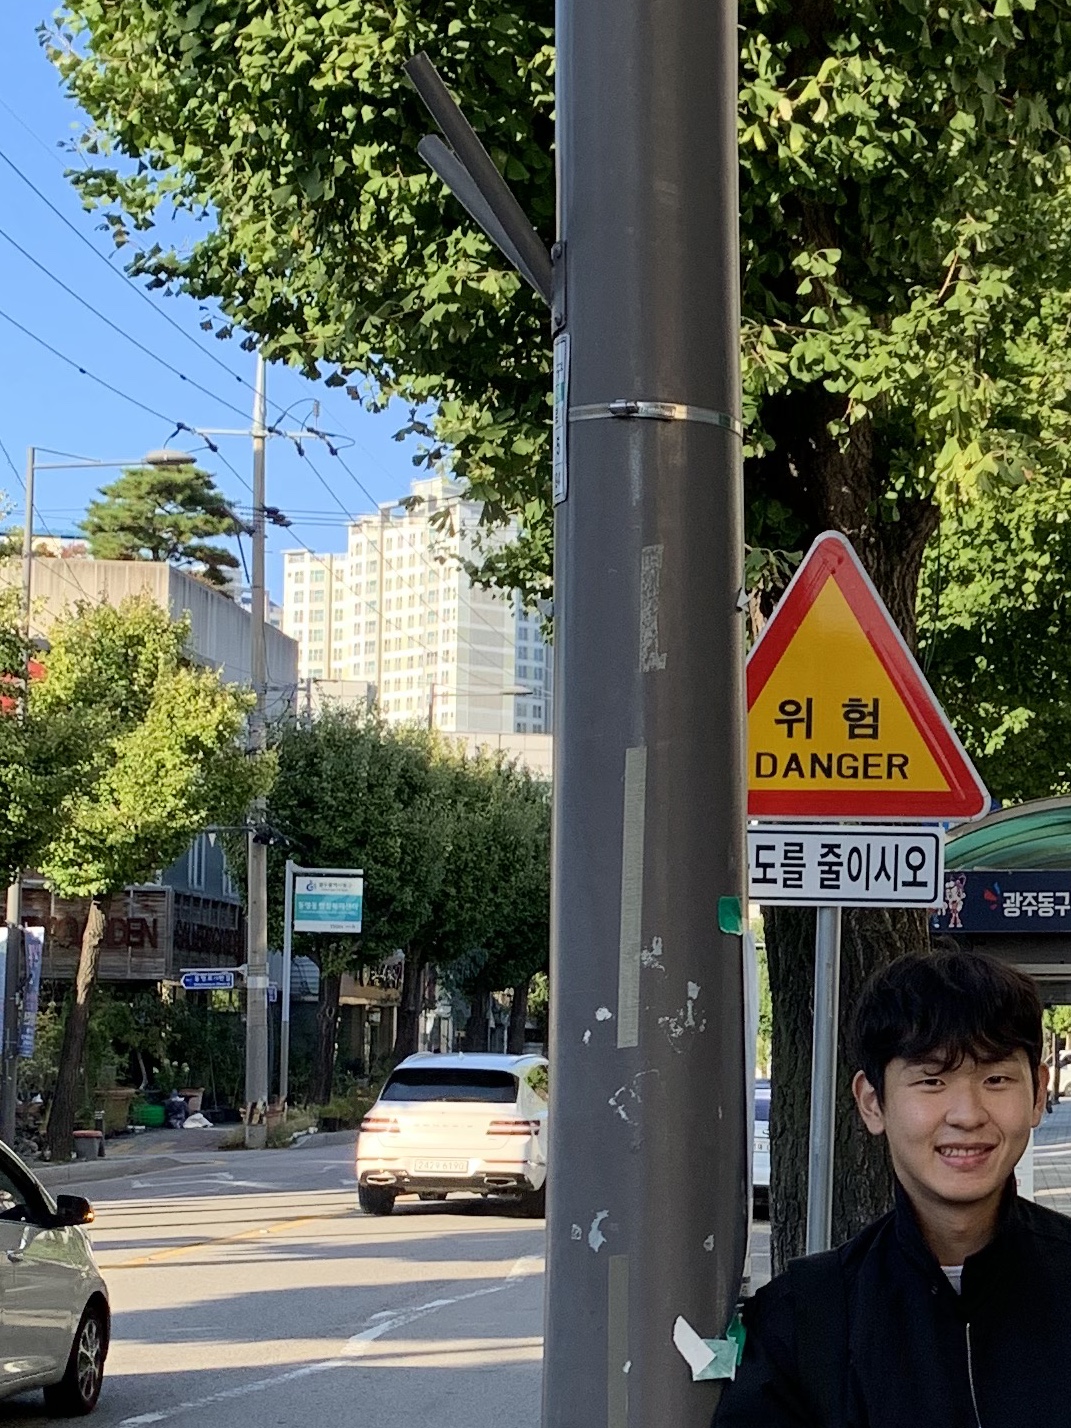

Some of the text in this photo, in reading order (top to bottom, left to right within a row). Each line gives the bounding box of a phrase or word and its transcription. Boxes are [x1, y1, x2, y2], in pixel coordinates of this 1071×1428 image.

[755, 752, 909, 780] DANGER
[747, 842, 928, 892] 도를 줄이시오
[1002, 892, 1071, 917] 광주동구
